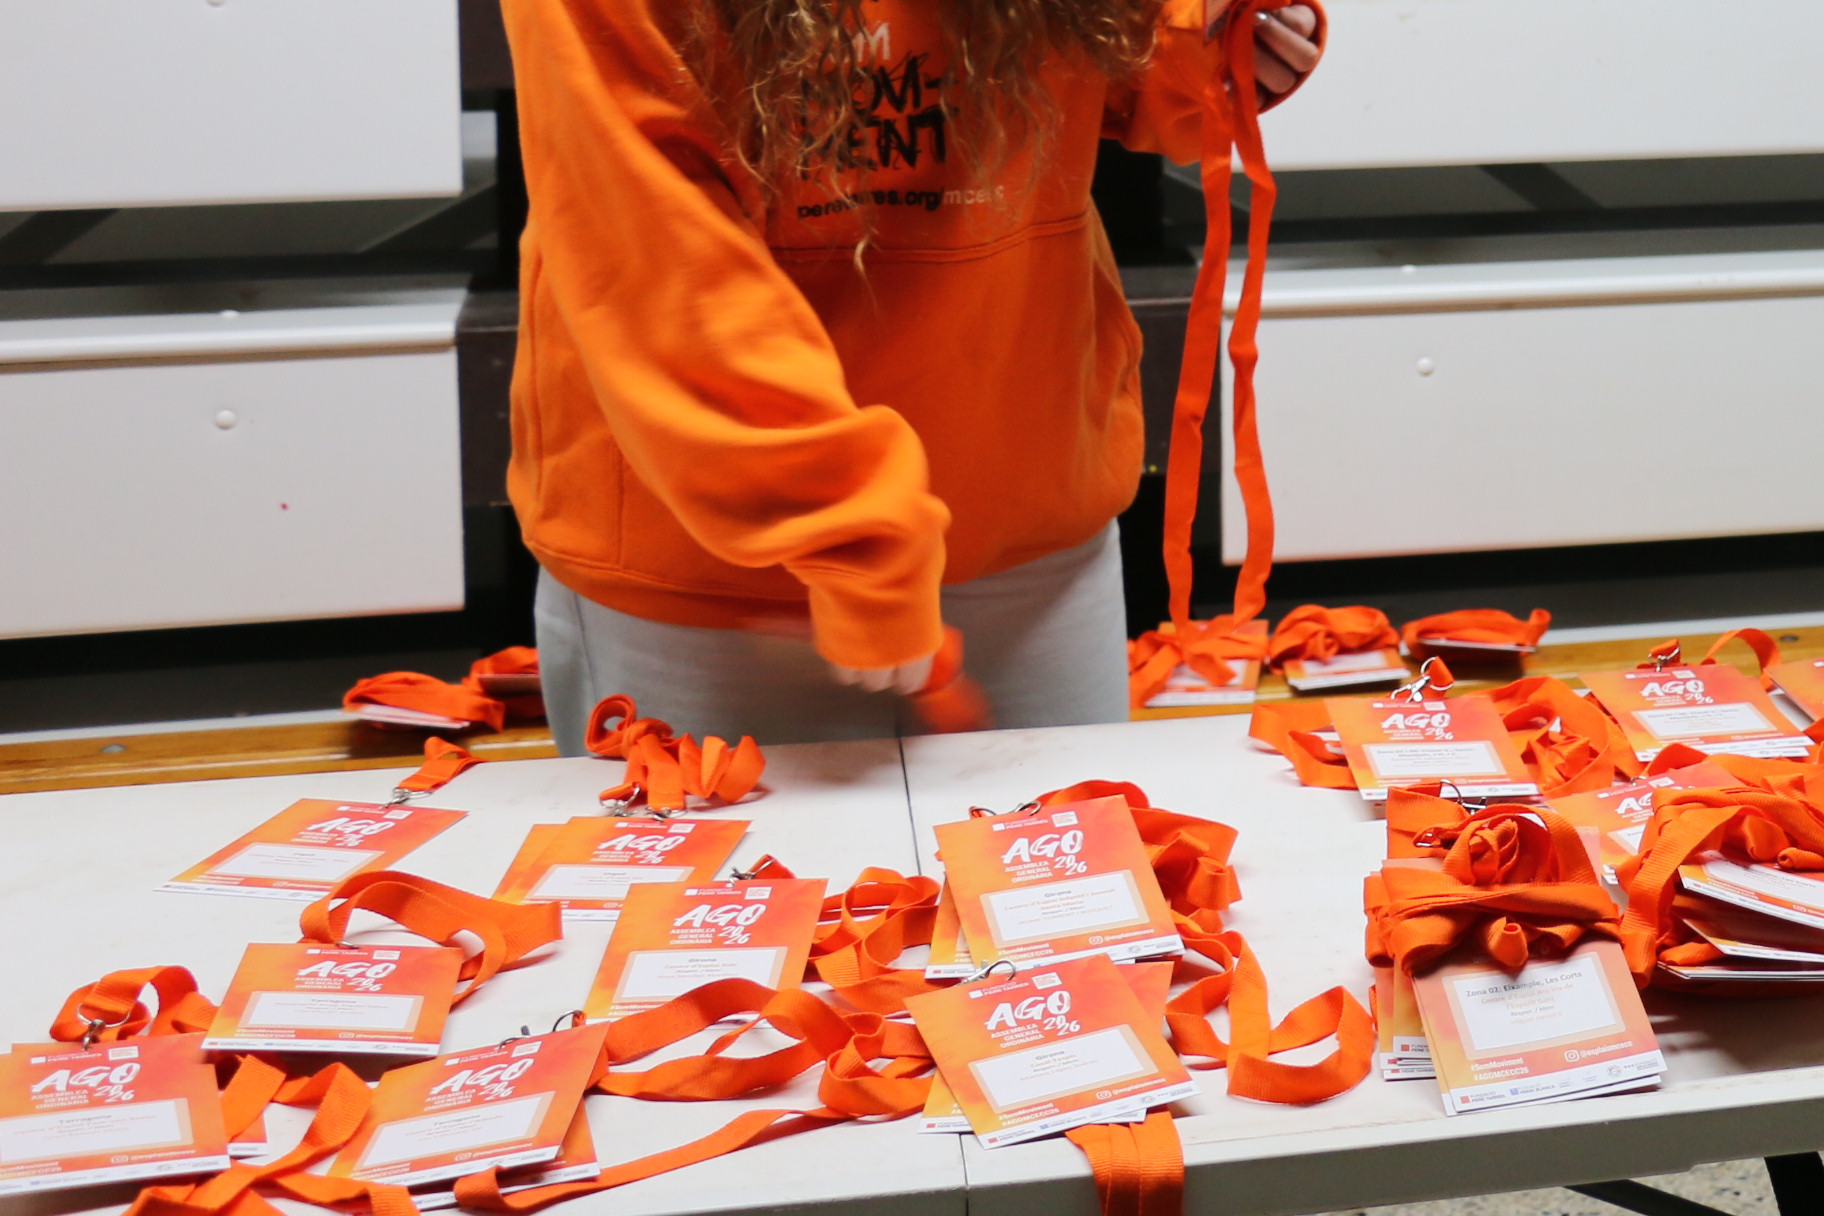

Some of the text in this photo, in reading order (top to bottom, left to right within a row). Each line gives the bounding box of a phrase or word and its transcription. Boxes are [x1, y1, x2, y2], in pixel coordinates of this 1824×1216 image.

[1640, 680, 1705, 696] AGO
[1381, 713, 1451, 729] AGO
[306, 817, 396, 835] AGO
[597, 834, 687, 852] AGO
[1001, 830, 1084, 864] AGO
[673, 904, 767, 927] AGO
[297, 960, 398, 978] AGO
[1466, 989, 1487, 998] Zona
[1489, 986, 1502, 994] 02:
[1545, 976, 1559, 984] Les
[1560, 971, 1582, 980] Corts
[984, 990, 1072, 1030] AGO
[1043, 1015, 1067, 1030] 20
[1057, 1020, 1080, 1036] 26
[1004, 1029, 1042, 1042] GENERAL
[1035, 1051, 1064, 1060] Girona
[1471, 1057, 1524, 1070] #SomMoviment
[31, 1062, 141, 1094] AGO
[430, 1058, 534, 1095] AGO
